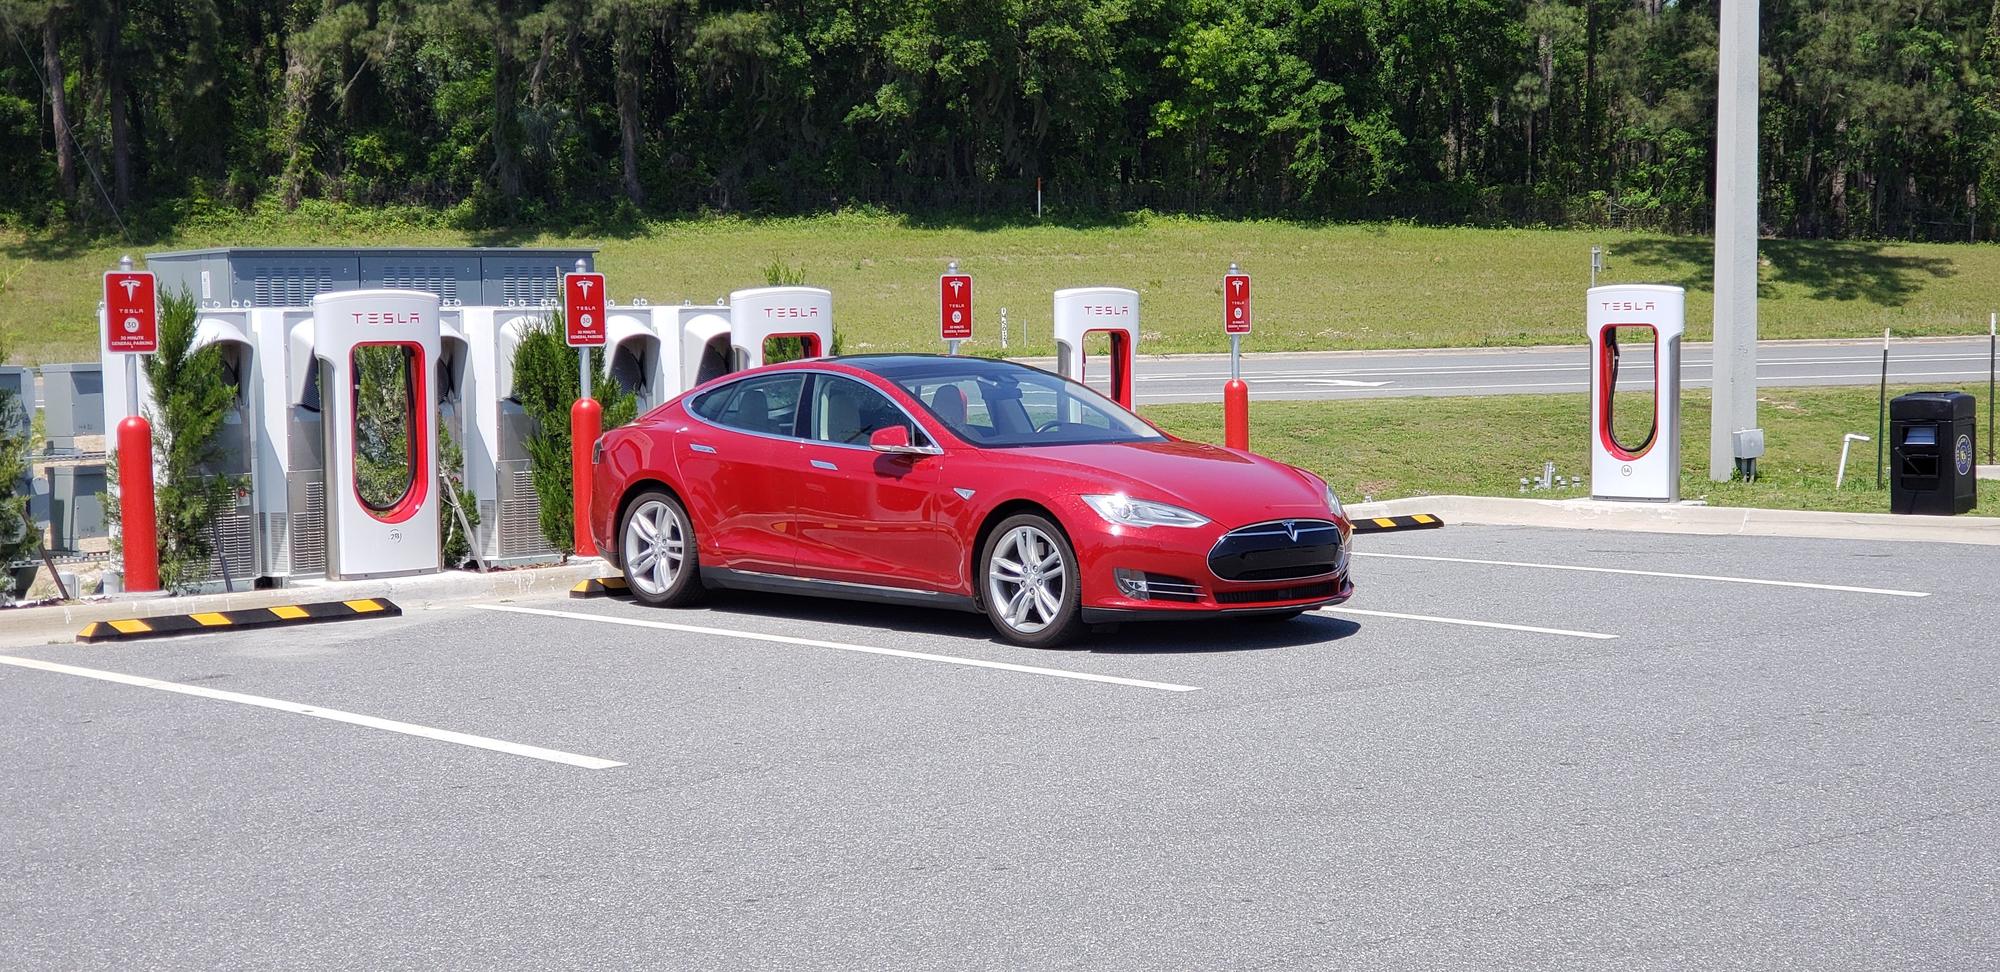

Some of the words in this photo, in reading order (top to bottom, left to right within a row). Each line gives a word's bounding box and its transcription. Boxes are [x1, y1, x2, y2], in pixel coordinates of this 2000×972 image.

[1084, 306, 1129, 315] TESLA
[1601, 302, 1655, 311] TESLA
[763, 307, 818, 318] TESLA
[351, 312, 420, 324] TESLA
[126, 321, 137, 329] 30
